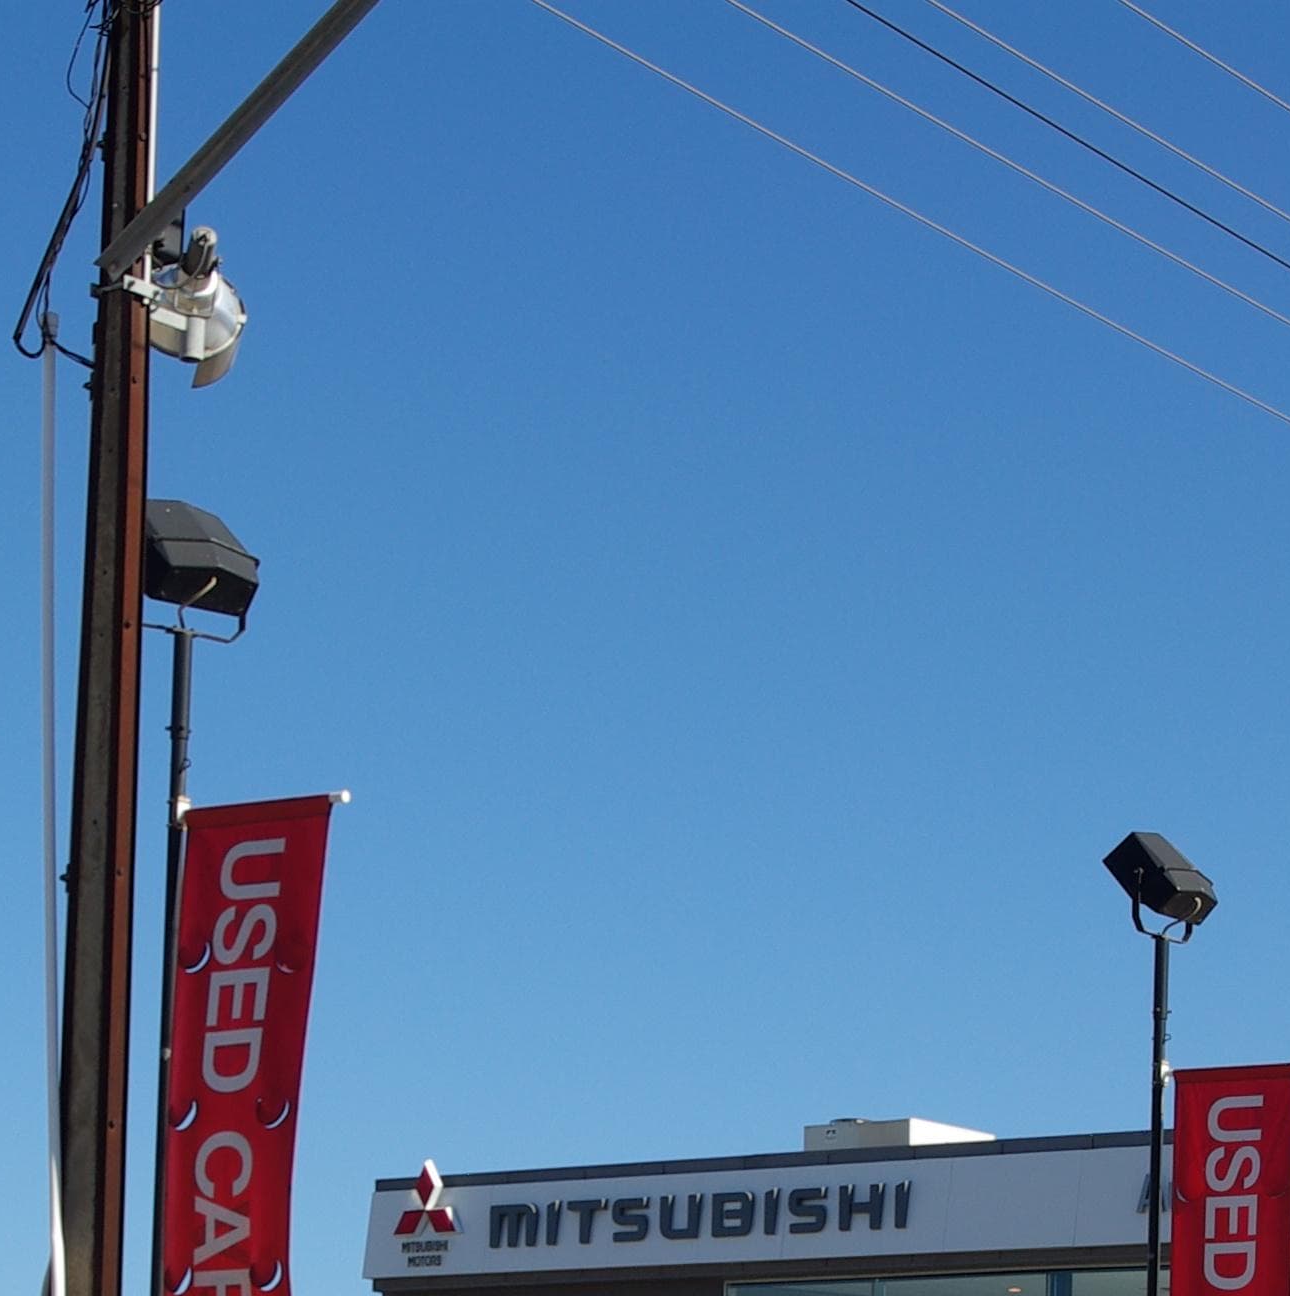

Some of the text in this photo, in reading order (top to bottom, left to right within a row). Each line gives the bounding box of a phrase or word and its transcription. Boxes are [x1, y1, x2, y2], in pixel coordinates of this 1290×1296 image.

[202, 837, 286, 1093] USED
[489, 1180, 912, 1249] MITSUBISHI
[1203, 1094, 1264, 1290] USED
[401, 1240, 449, 1253] MITSUBISHI
[407, 1255, 442, 1267] MOTORS
